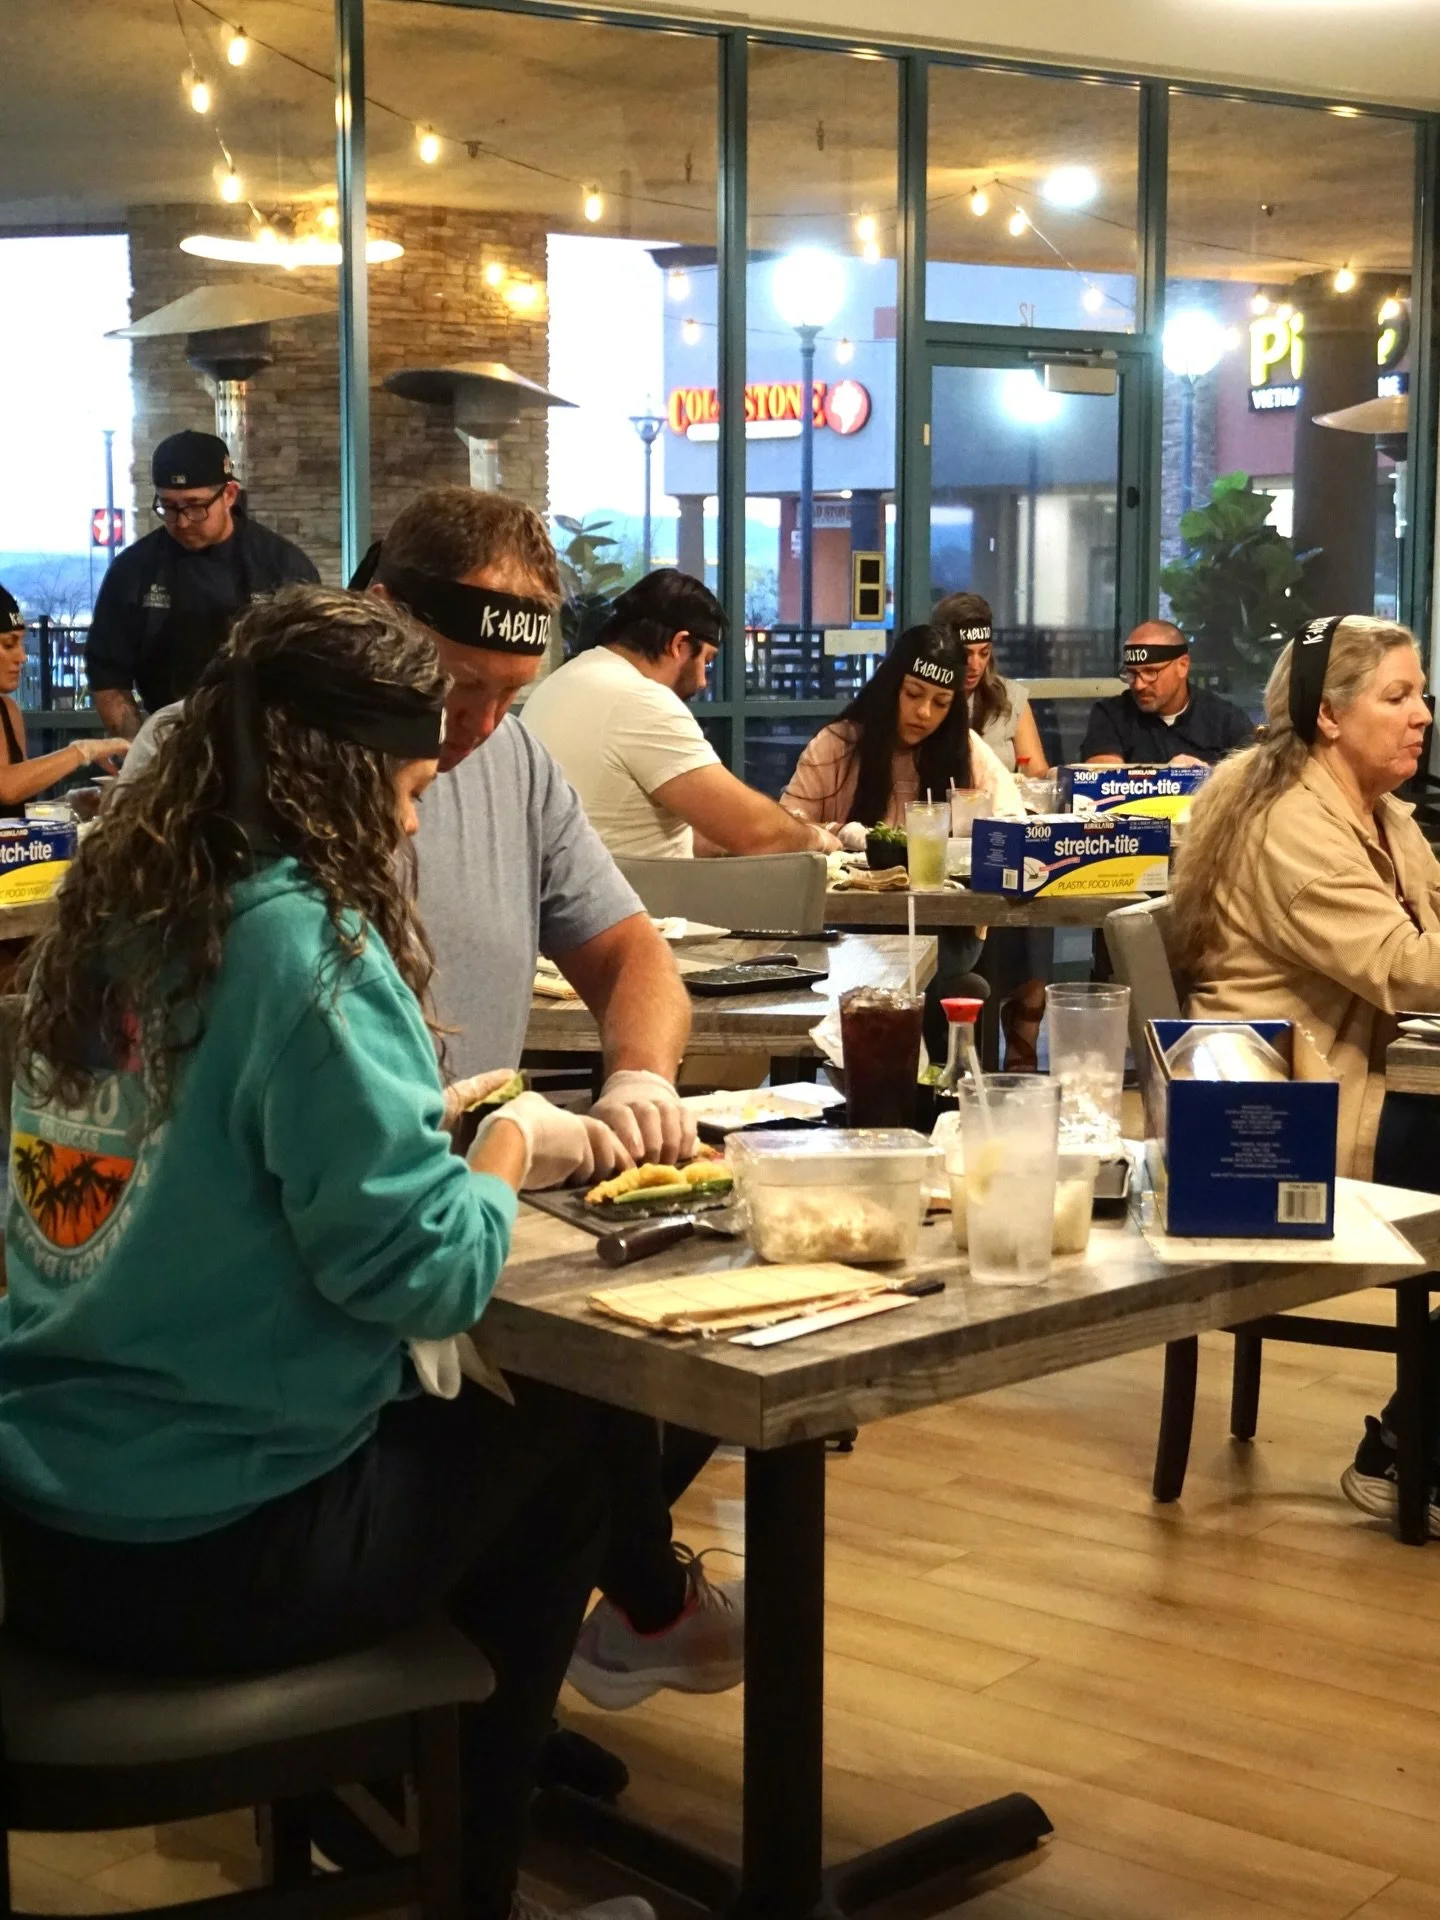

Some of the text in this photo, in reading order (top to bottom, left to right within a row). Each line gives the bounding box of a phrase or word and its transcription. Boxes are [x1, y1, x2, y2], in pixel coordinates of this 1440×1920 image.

[959, 626, 991, 641] KABUTO
[912, 656, 955, 684] KABUTO
[1074, 771, 1098, 781] 3000
[1101, 779, 1181, 795] stretch-tite
[1025, 826, 1051, 839] 3000
[1084, 822, 1115, 830] KIRKLAND
[0, 841, 52, 863] tch-tite
[1054, 835, 1139, 856] stretch-tite
[1058, 879, 1087, 890] PLASTIC
[1088, 879, 1111, 889] FOOD
[1111, 878, 1135, 888] WRAP
